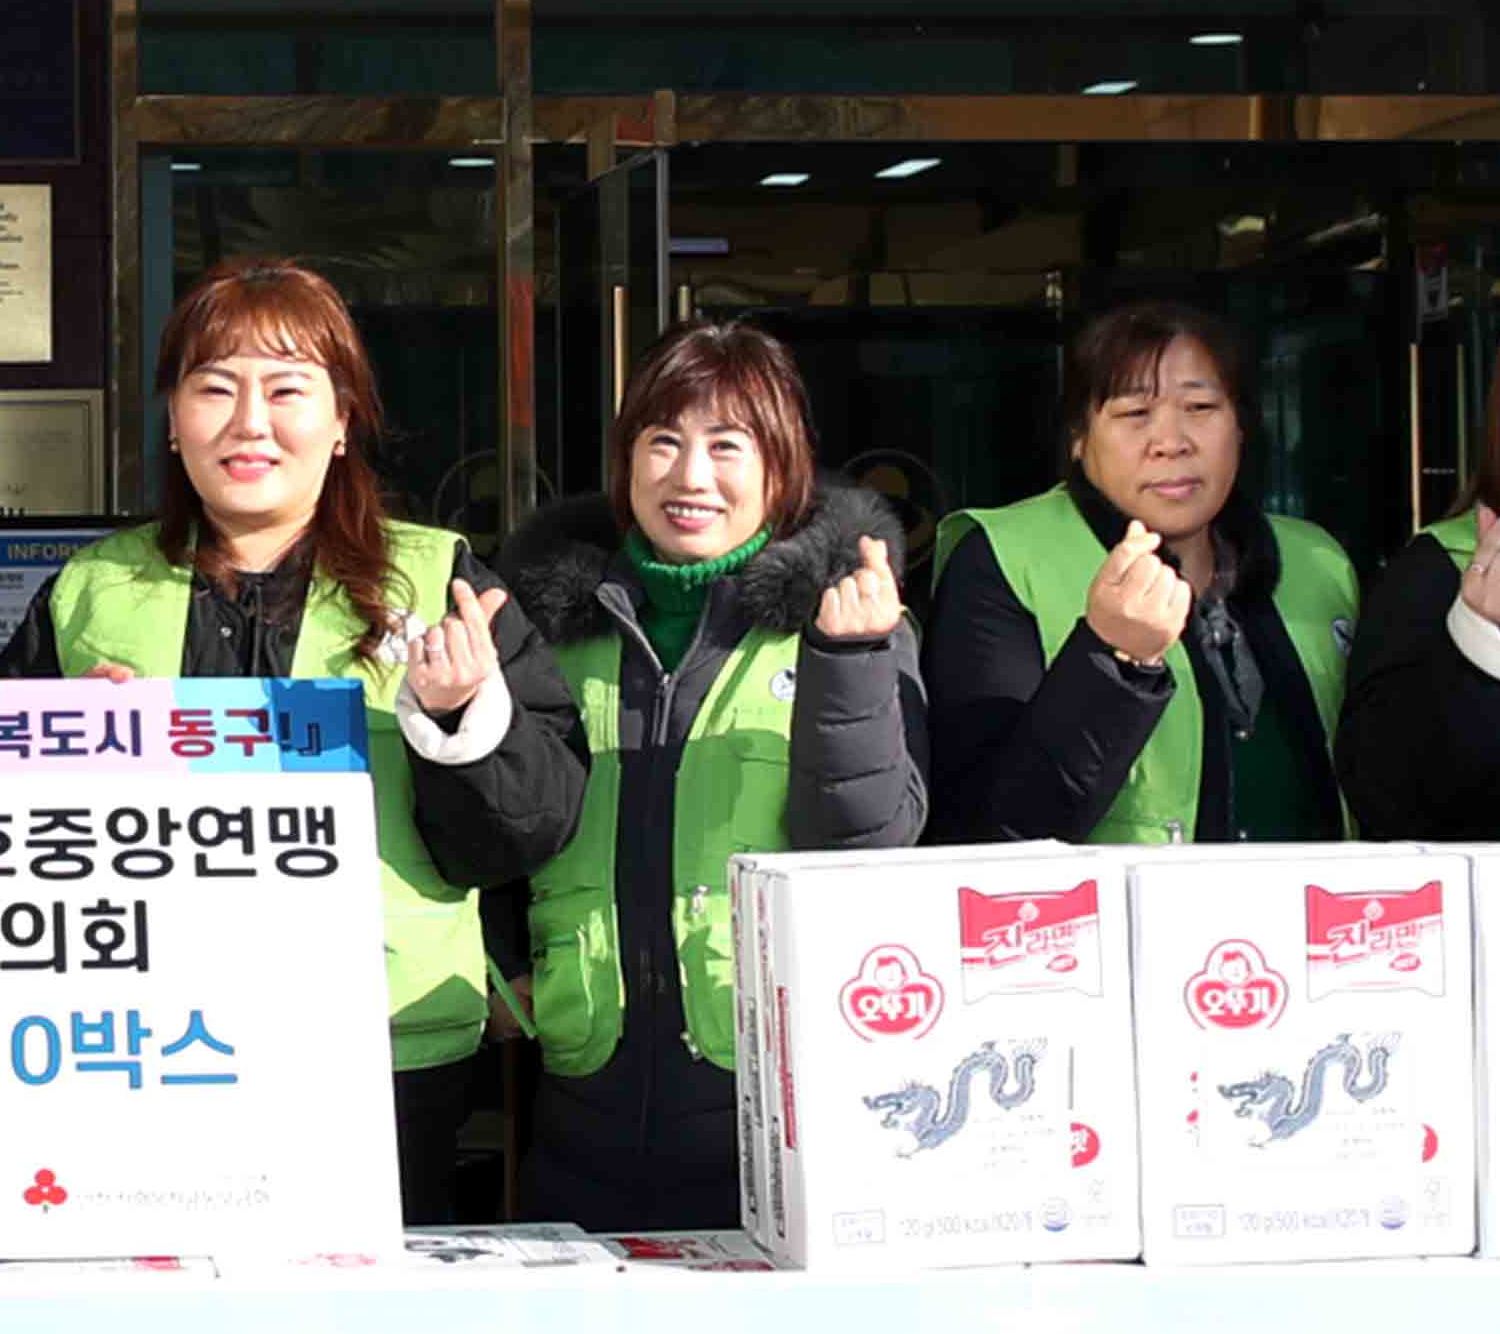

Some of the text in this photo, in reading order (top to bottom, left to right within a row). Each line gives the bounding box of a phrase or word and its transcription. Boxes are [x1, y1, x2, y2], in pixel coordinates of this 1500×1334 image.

[6, 543, 75, 561] INFOR
[984, 922, 1077, 964] 진라면
[1331, 921, 1421, 963] 진라면
[856, 992, 926, 1024] 오뚜기
[1202, 988, 1272, 1021] 오뚜기
